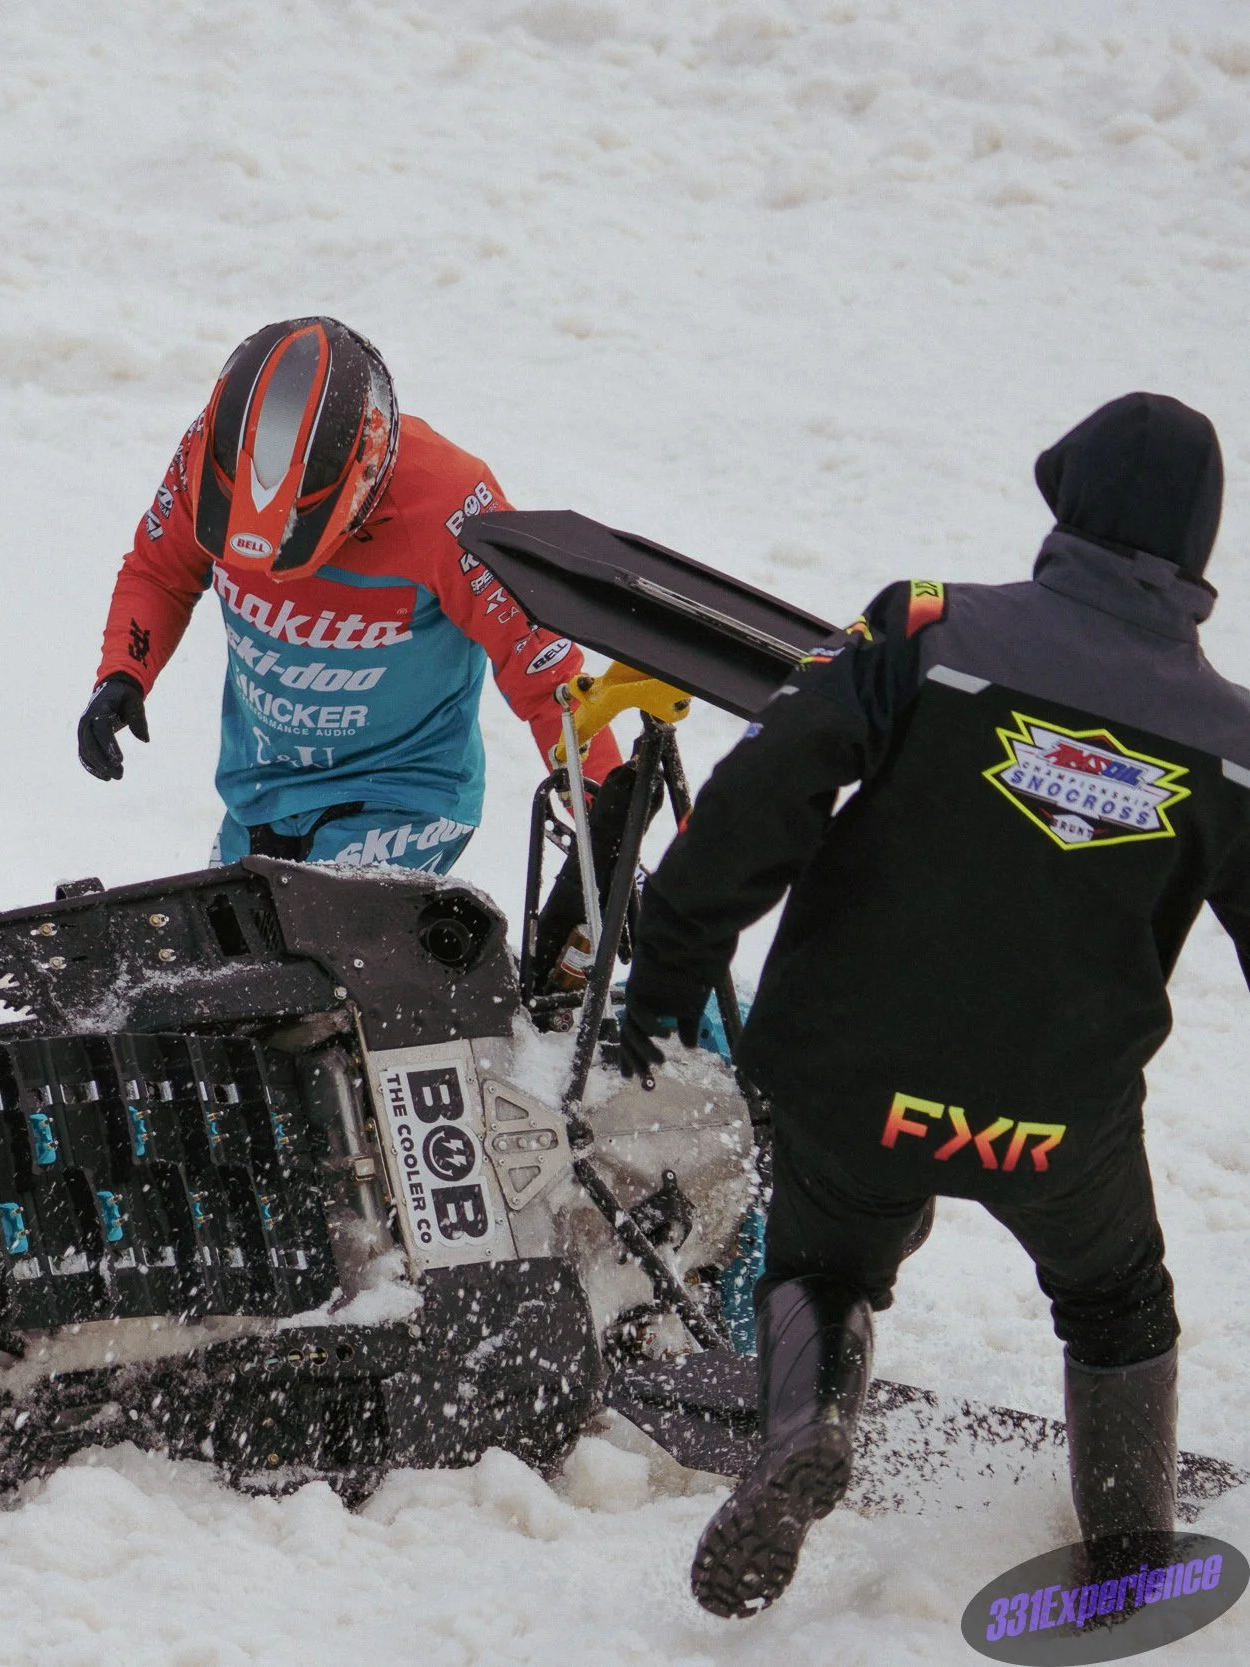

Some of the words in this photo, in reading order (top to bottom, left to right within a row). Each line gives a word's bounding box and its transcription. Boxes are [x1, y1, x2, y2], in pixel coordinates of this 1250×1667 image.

[236, 538, 265, 553] BELL
[213, 561, 414, 649] makita
[532, 642, 568, 669] BELL
[242, 696, 309, 736] RFORMANCE
[316, 728, 356, 737] AUDIO
[249, 680, 369, 728] KICKER
[1010, 769, 1150, 825] SNOCROSS
[387, 1073, 408, 1117] THE
[406, 1067, 488, 1240] BOB
[880, 1091, 1067, 1173] FXR
[397, 1124, 427, 1212] COOLER
[417, 1218, 432, 1243] CO
